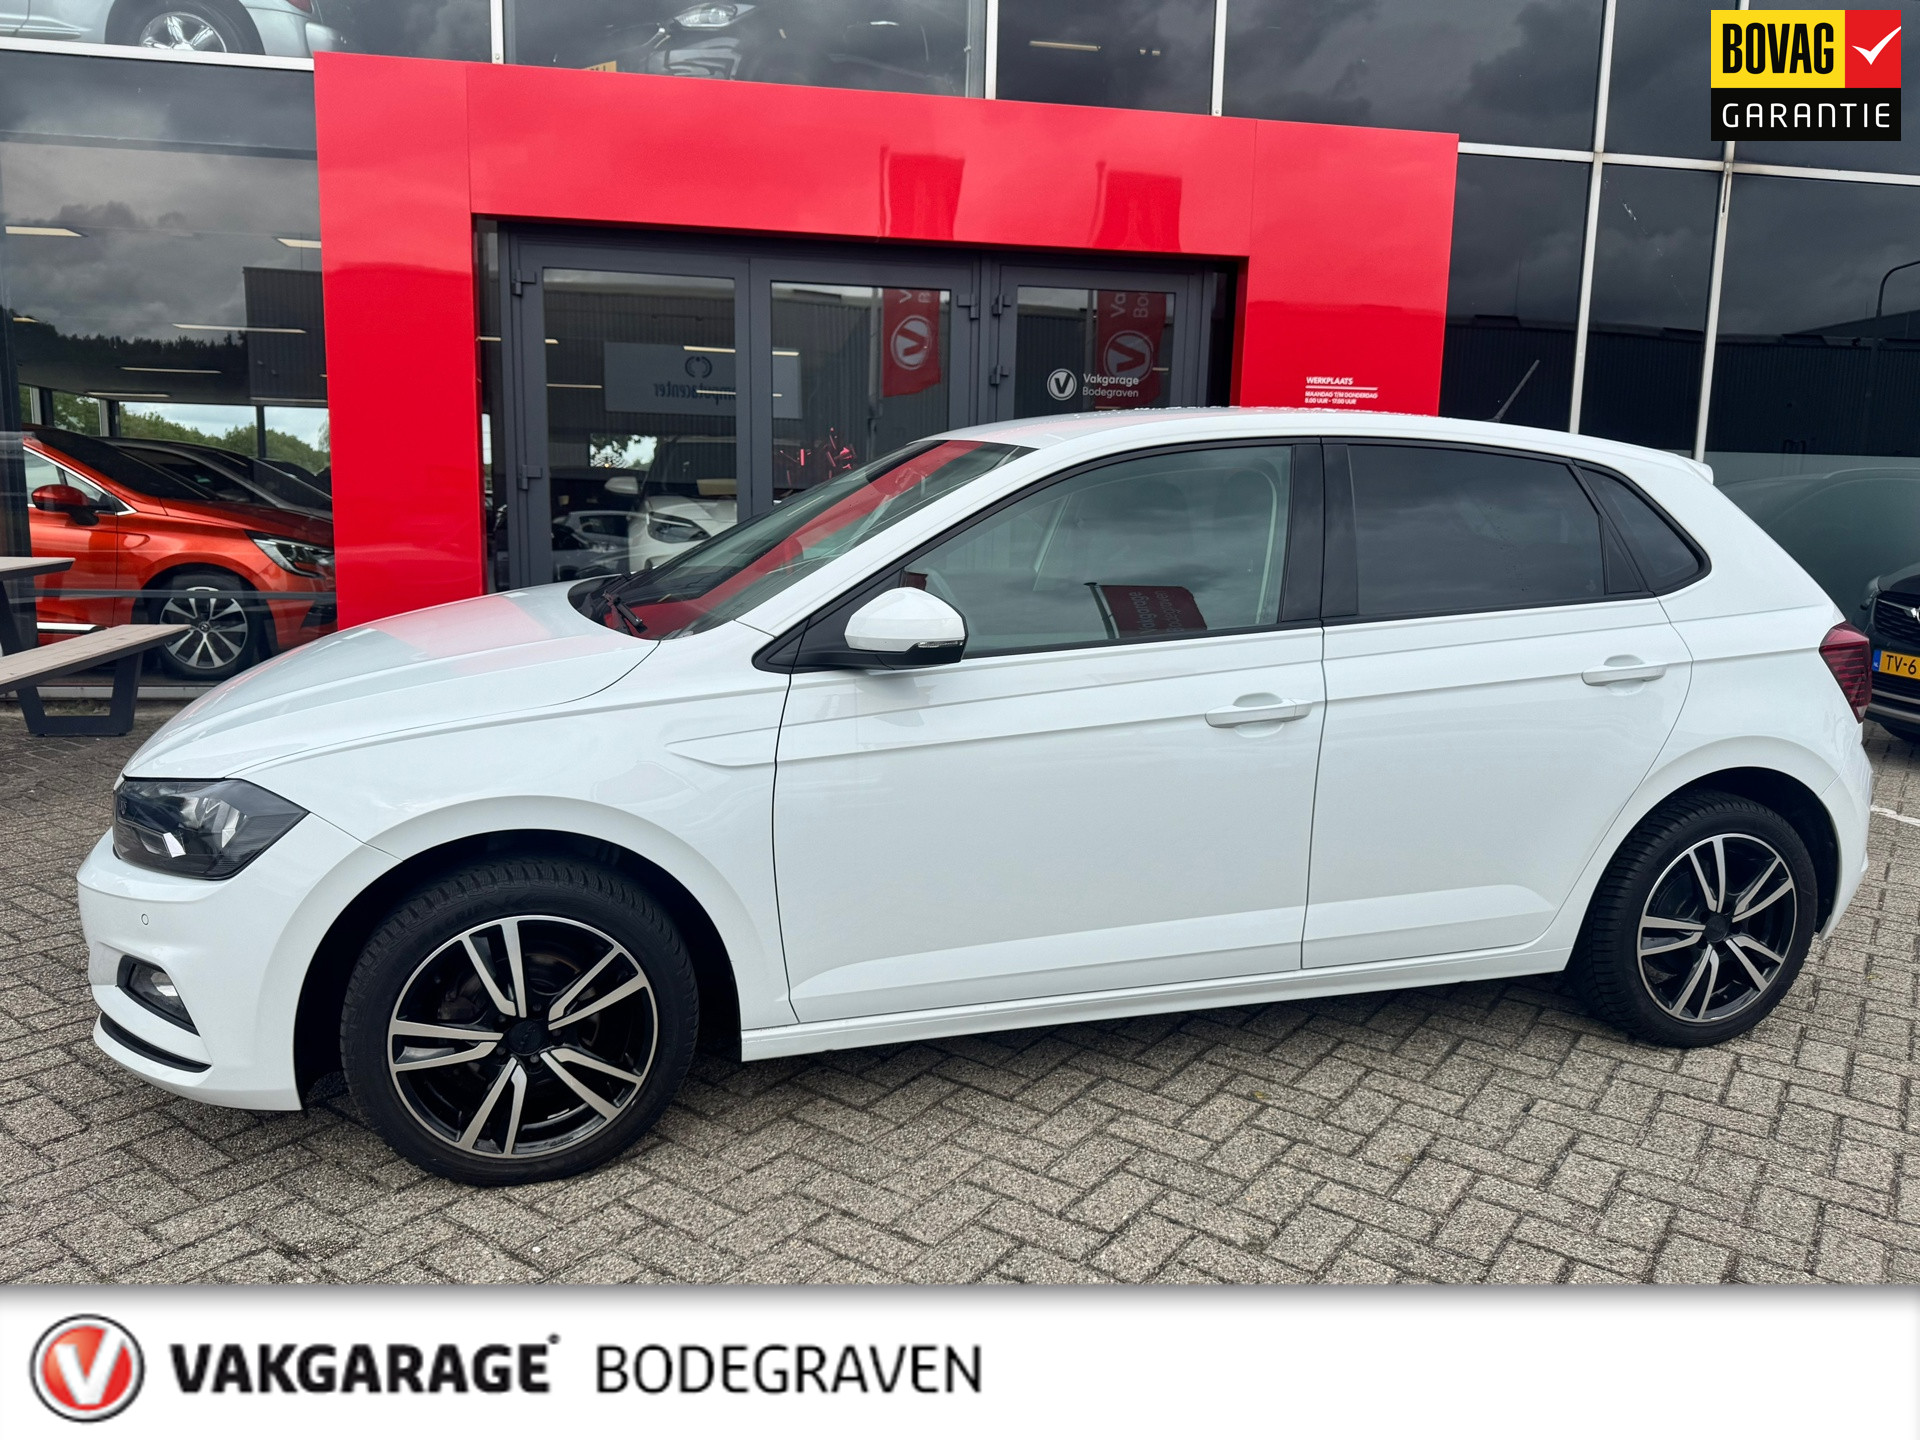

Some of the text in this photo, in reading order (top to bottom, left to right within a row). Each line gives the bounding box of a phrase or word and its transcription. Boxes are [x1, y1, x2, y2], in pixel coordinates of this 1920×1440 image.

[1082, 373, 1140, 387] Vakgarage
[1306, 376, 1354, 385] WERKPLAATS
[1082, 386, 1139, 399] Bodegraven
[1886, 654, 1917, 675] TV-6
